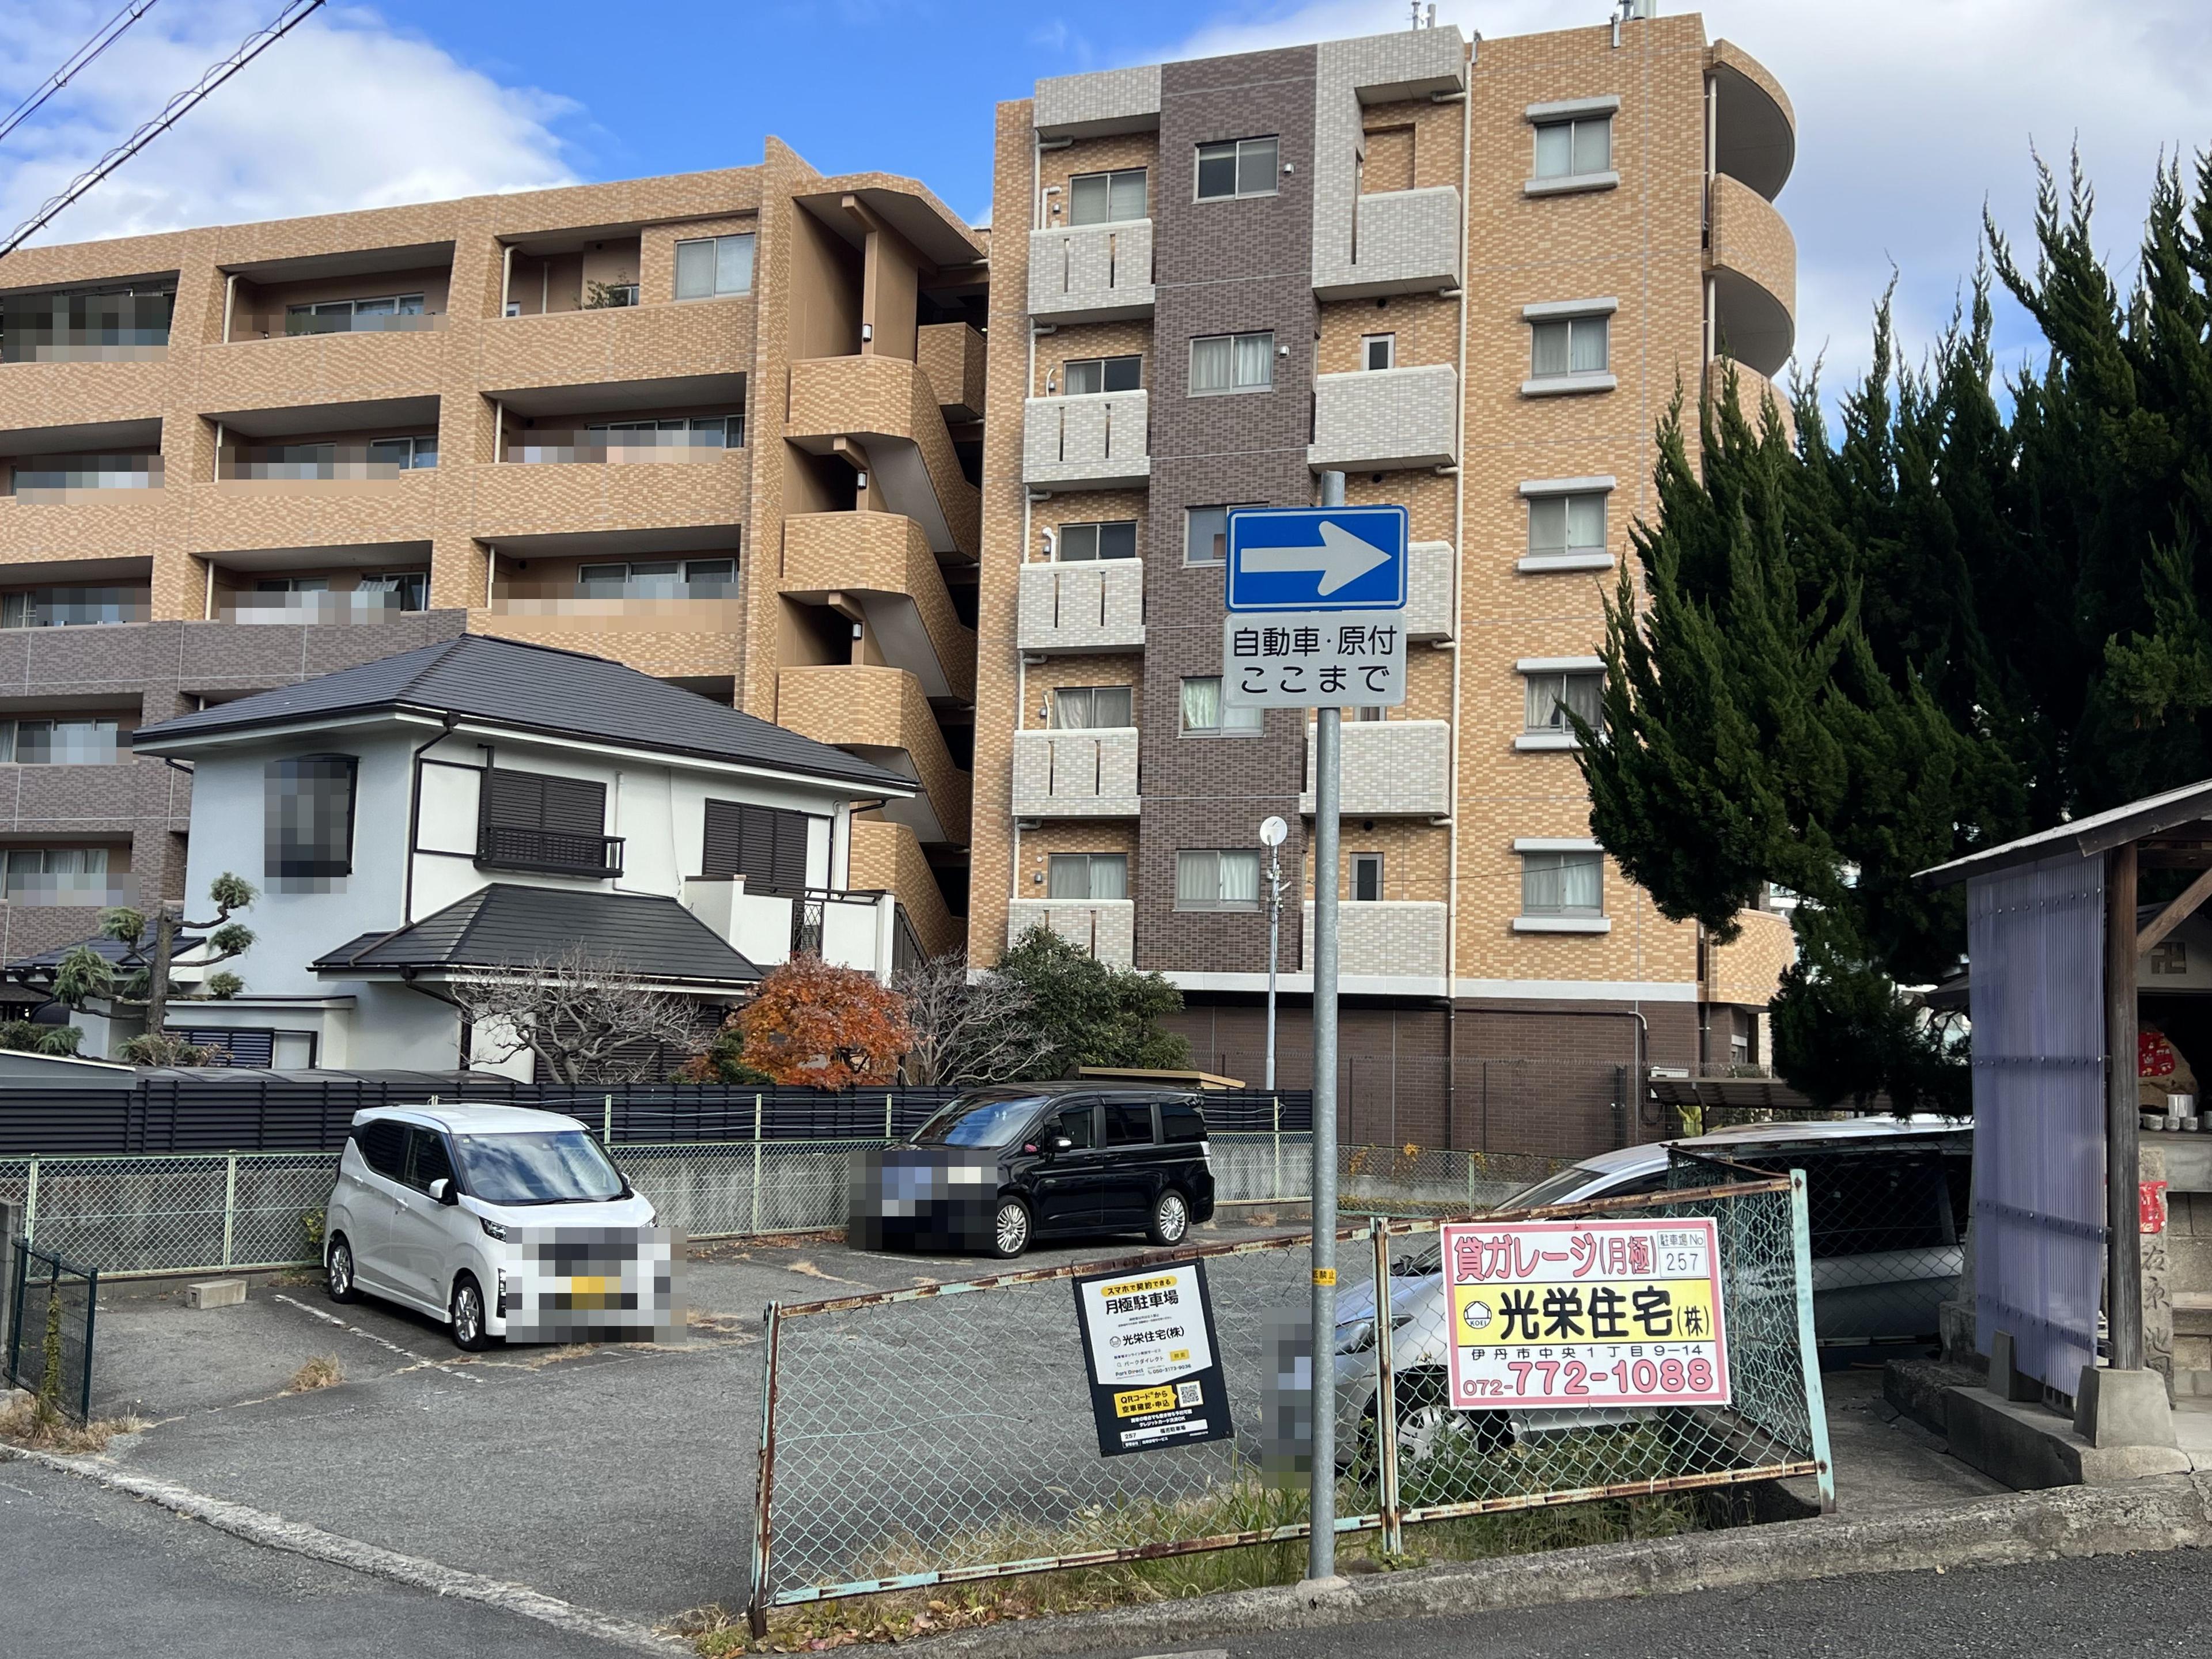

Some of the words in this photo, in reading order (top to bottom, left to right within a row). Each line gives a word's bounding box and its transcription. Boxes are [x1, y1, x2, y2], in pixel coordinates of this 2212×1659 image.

[1234, 625, 1397, 657] 自動車・原付
[1241, 665, 1390, 694] ここまで
[1666, 1253, 1698, 1271] 257
[1107, 1279, 1172, 1296] スマホで契約できる
[1105, 1290, 1179, 1315] 月極駐車場
[1123, 1325, 1184, 1346] 光栄住宅(株)
[1124, 1356, 1164, 1367] パークダイレクト
[1463, 1357, 1713, 1396] 072-772-1088
